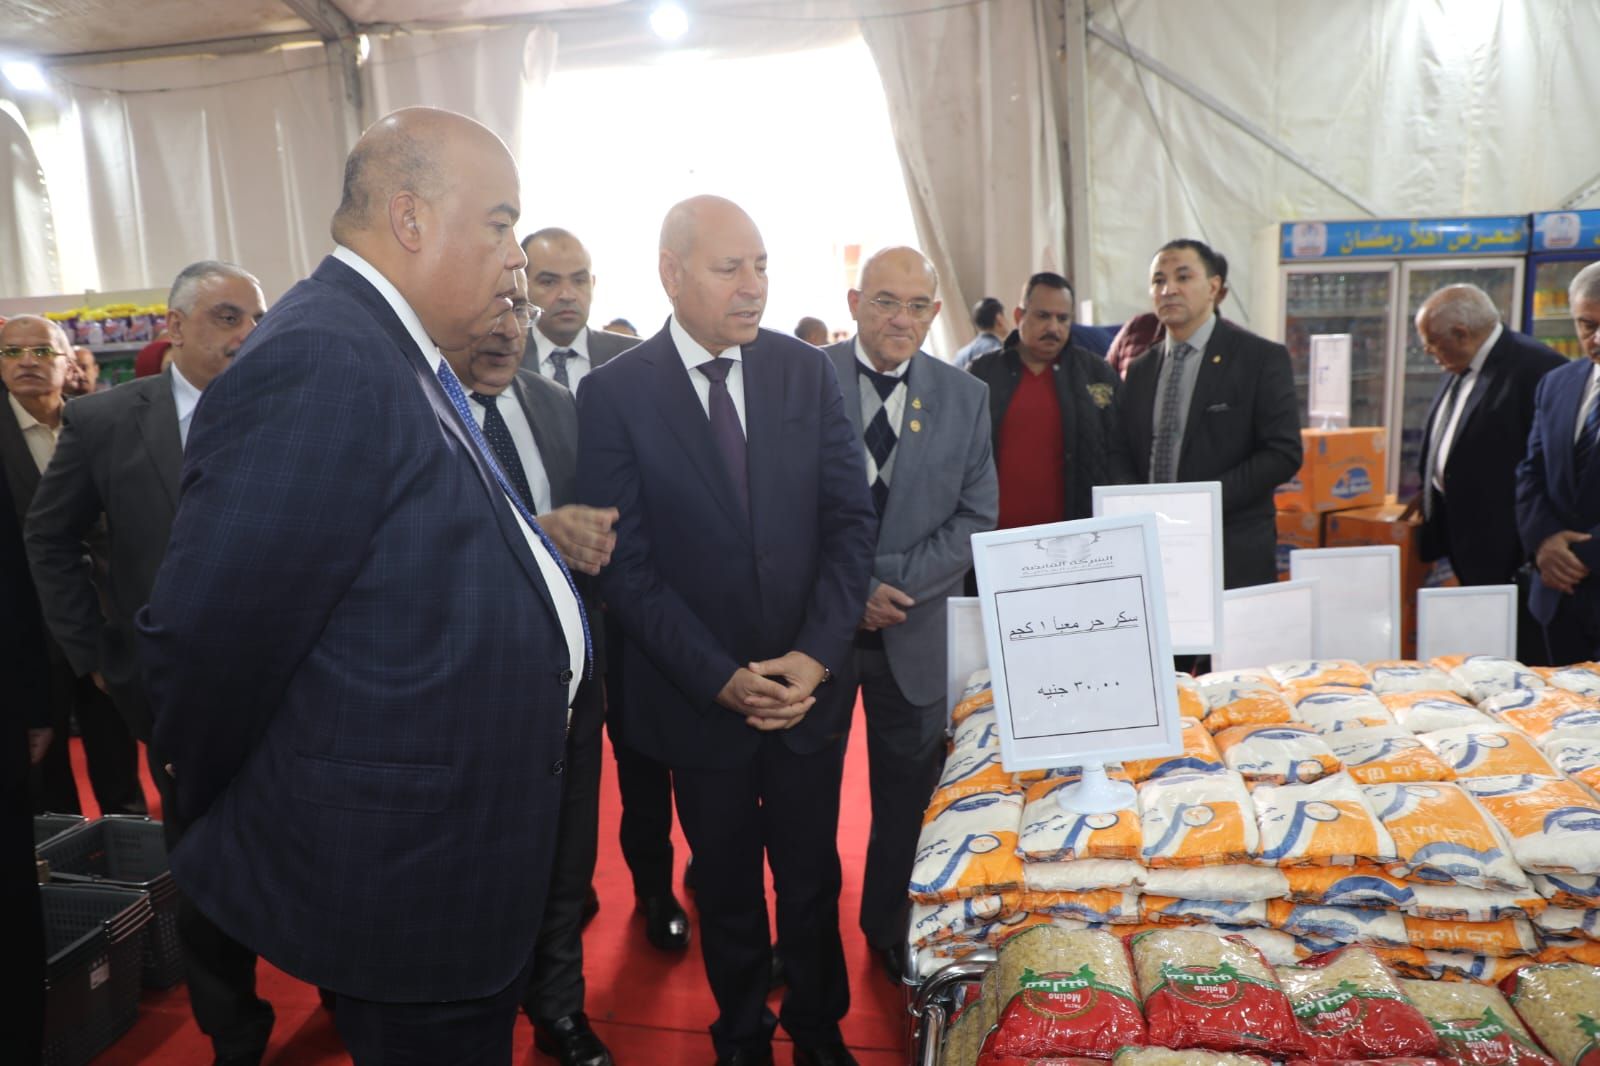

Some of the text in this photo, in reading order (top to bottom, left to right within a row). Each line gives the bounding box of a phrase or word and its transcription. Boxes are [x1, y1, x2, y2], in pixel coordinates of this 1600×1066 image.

[1341, 226, 1404, 254] رمضان
[1070, 554, 1113, 565] الشركة
[1088, 617, 1104, 631] حر
[1113, 610, 1138, 627] سكر
[1009, 622, 1034, 638] كجم
[1037, 683, 1069, 699] جنيه
[1048, 992, 1081, 1003] Molino
[1193, 985, 1228, 995] Molino
